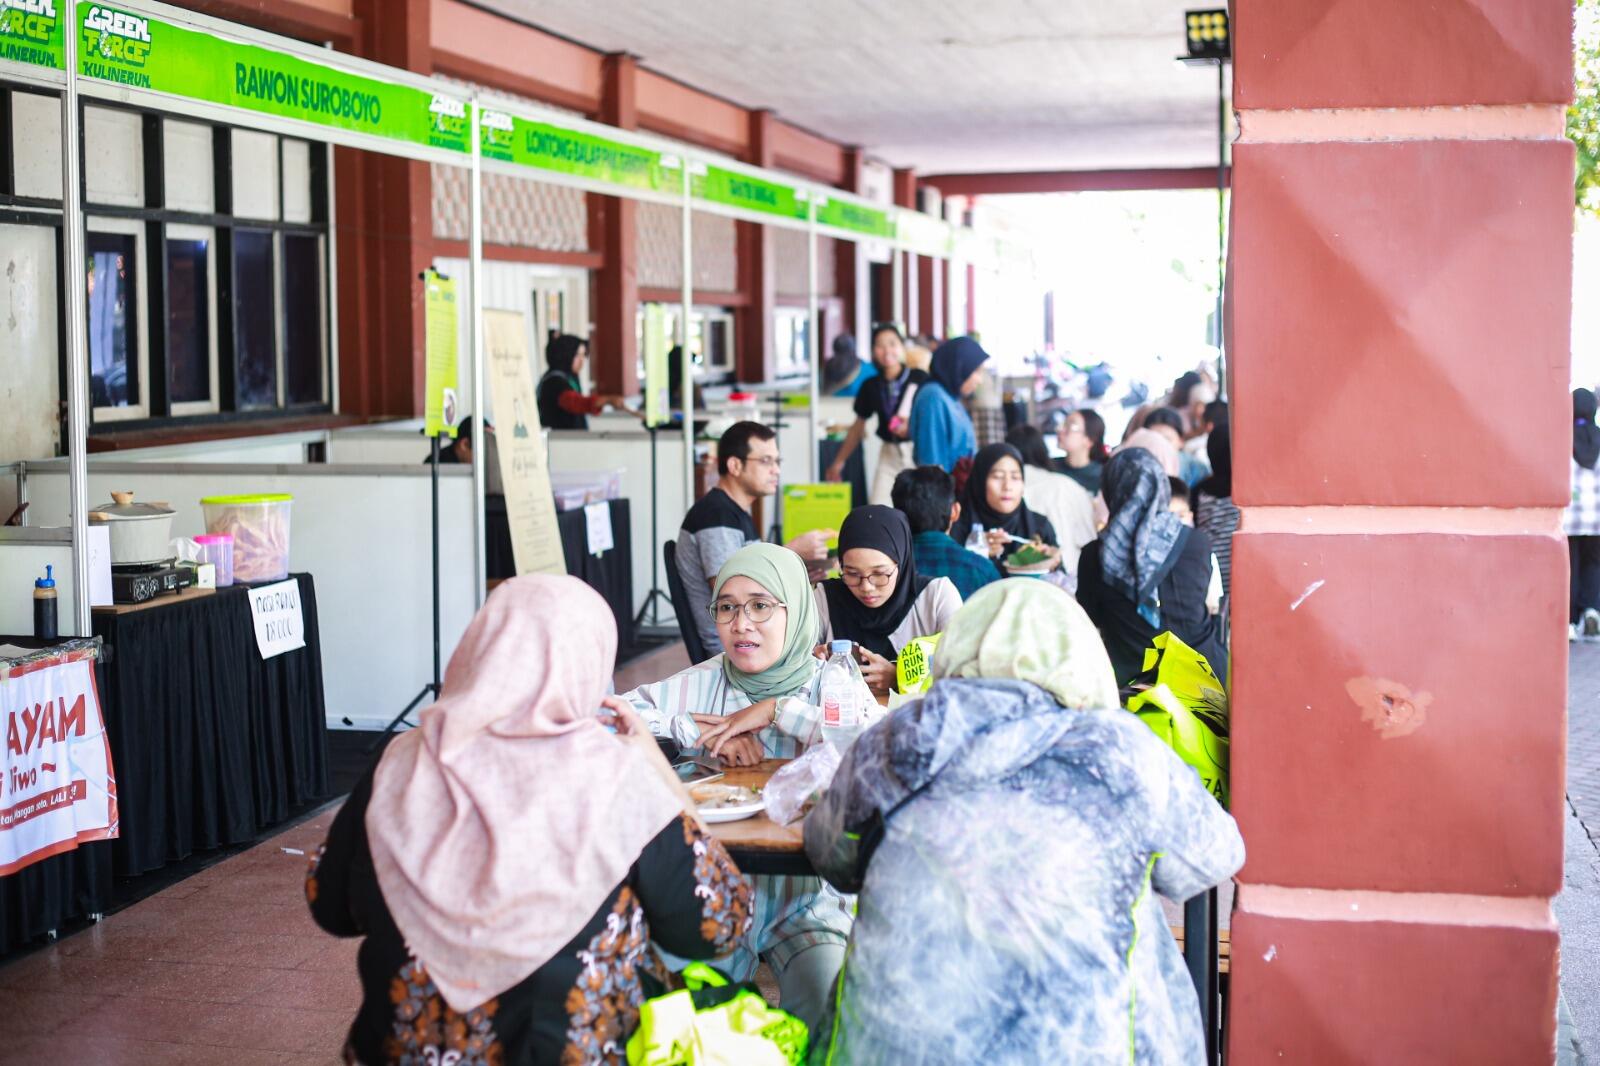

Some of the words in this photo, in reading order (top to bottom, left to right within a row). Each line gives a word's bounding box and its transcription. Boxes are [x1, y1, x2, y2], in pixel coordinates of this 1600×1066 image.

[84, 6, 151, 42] GREEN
[83, 28, 150, 65] FORCE
[235, 61, 298, 106] RAWON
[301, 77, 381, 125] SUROBOYO
[902, 643, 921, 658] AZA
[904, 653, 924, 669] RUN
[905, 664, 925, 681] ONE
[7, 693, 86, 757] AYAM
